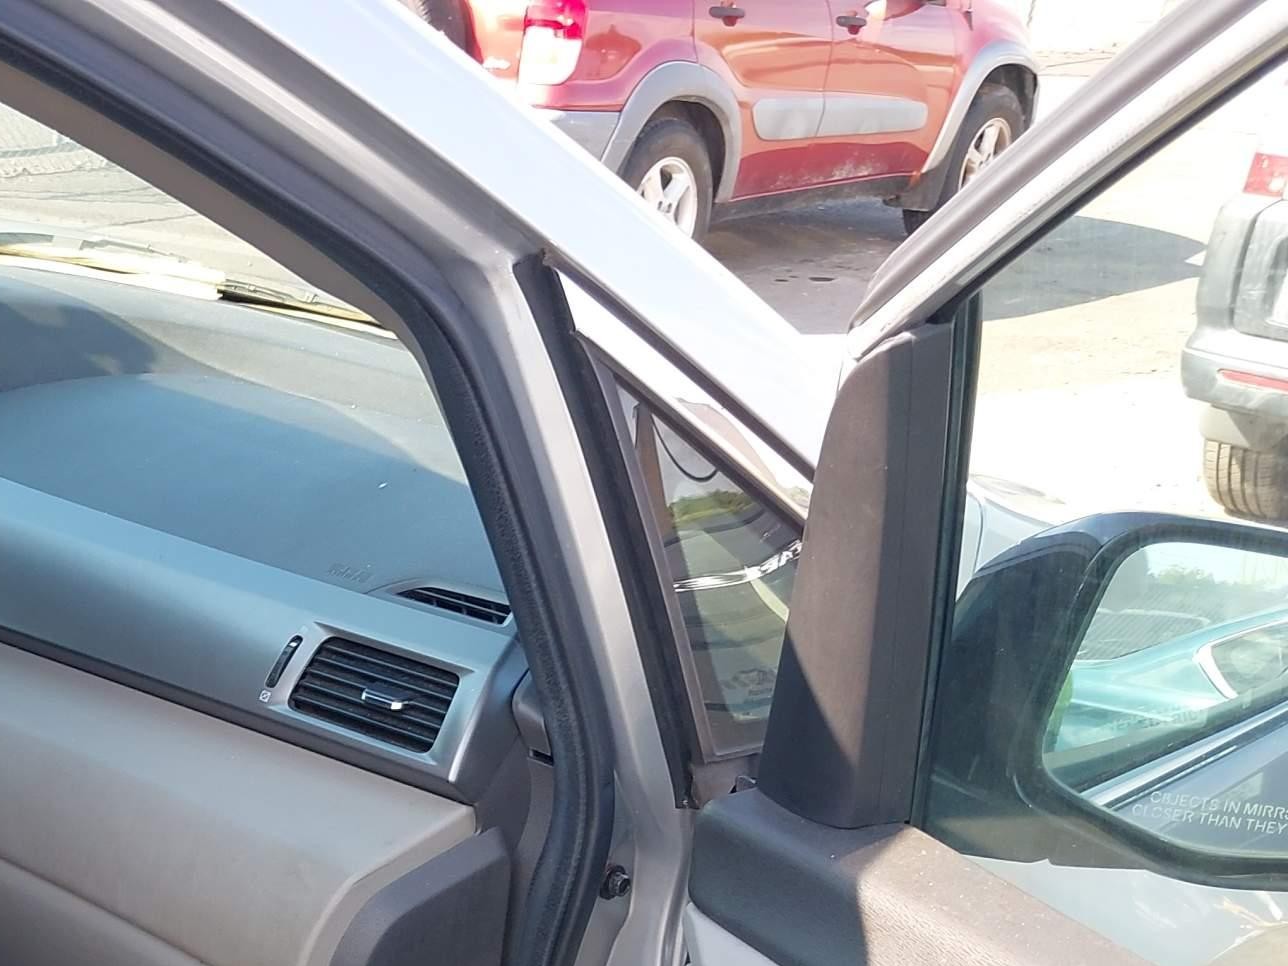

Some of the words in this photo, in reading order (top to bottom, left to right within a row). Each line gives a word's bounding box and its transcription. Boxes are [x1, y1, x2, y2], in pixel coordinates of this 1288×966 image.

[1150, 791, 1219, 811] OBJECTS
[1223, 799, 1241, 814] IN
[1132, 803, 1194, 823] CLOSER
[1199, 812, 1241, 829] THAN
[1245, 818, 1288, 835] THEY
